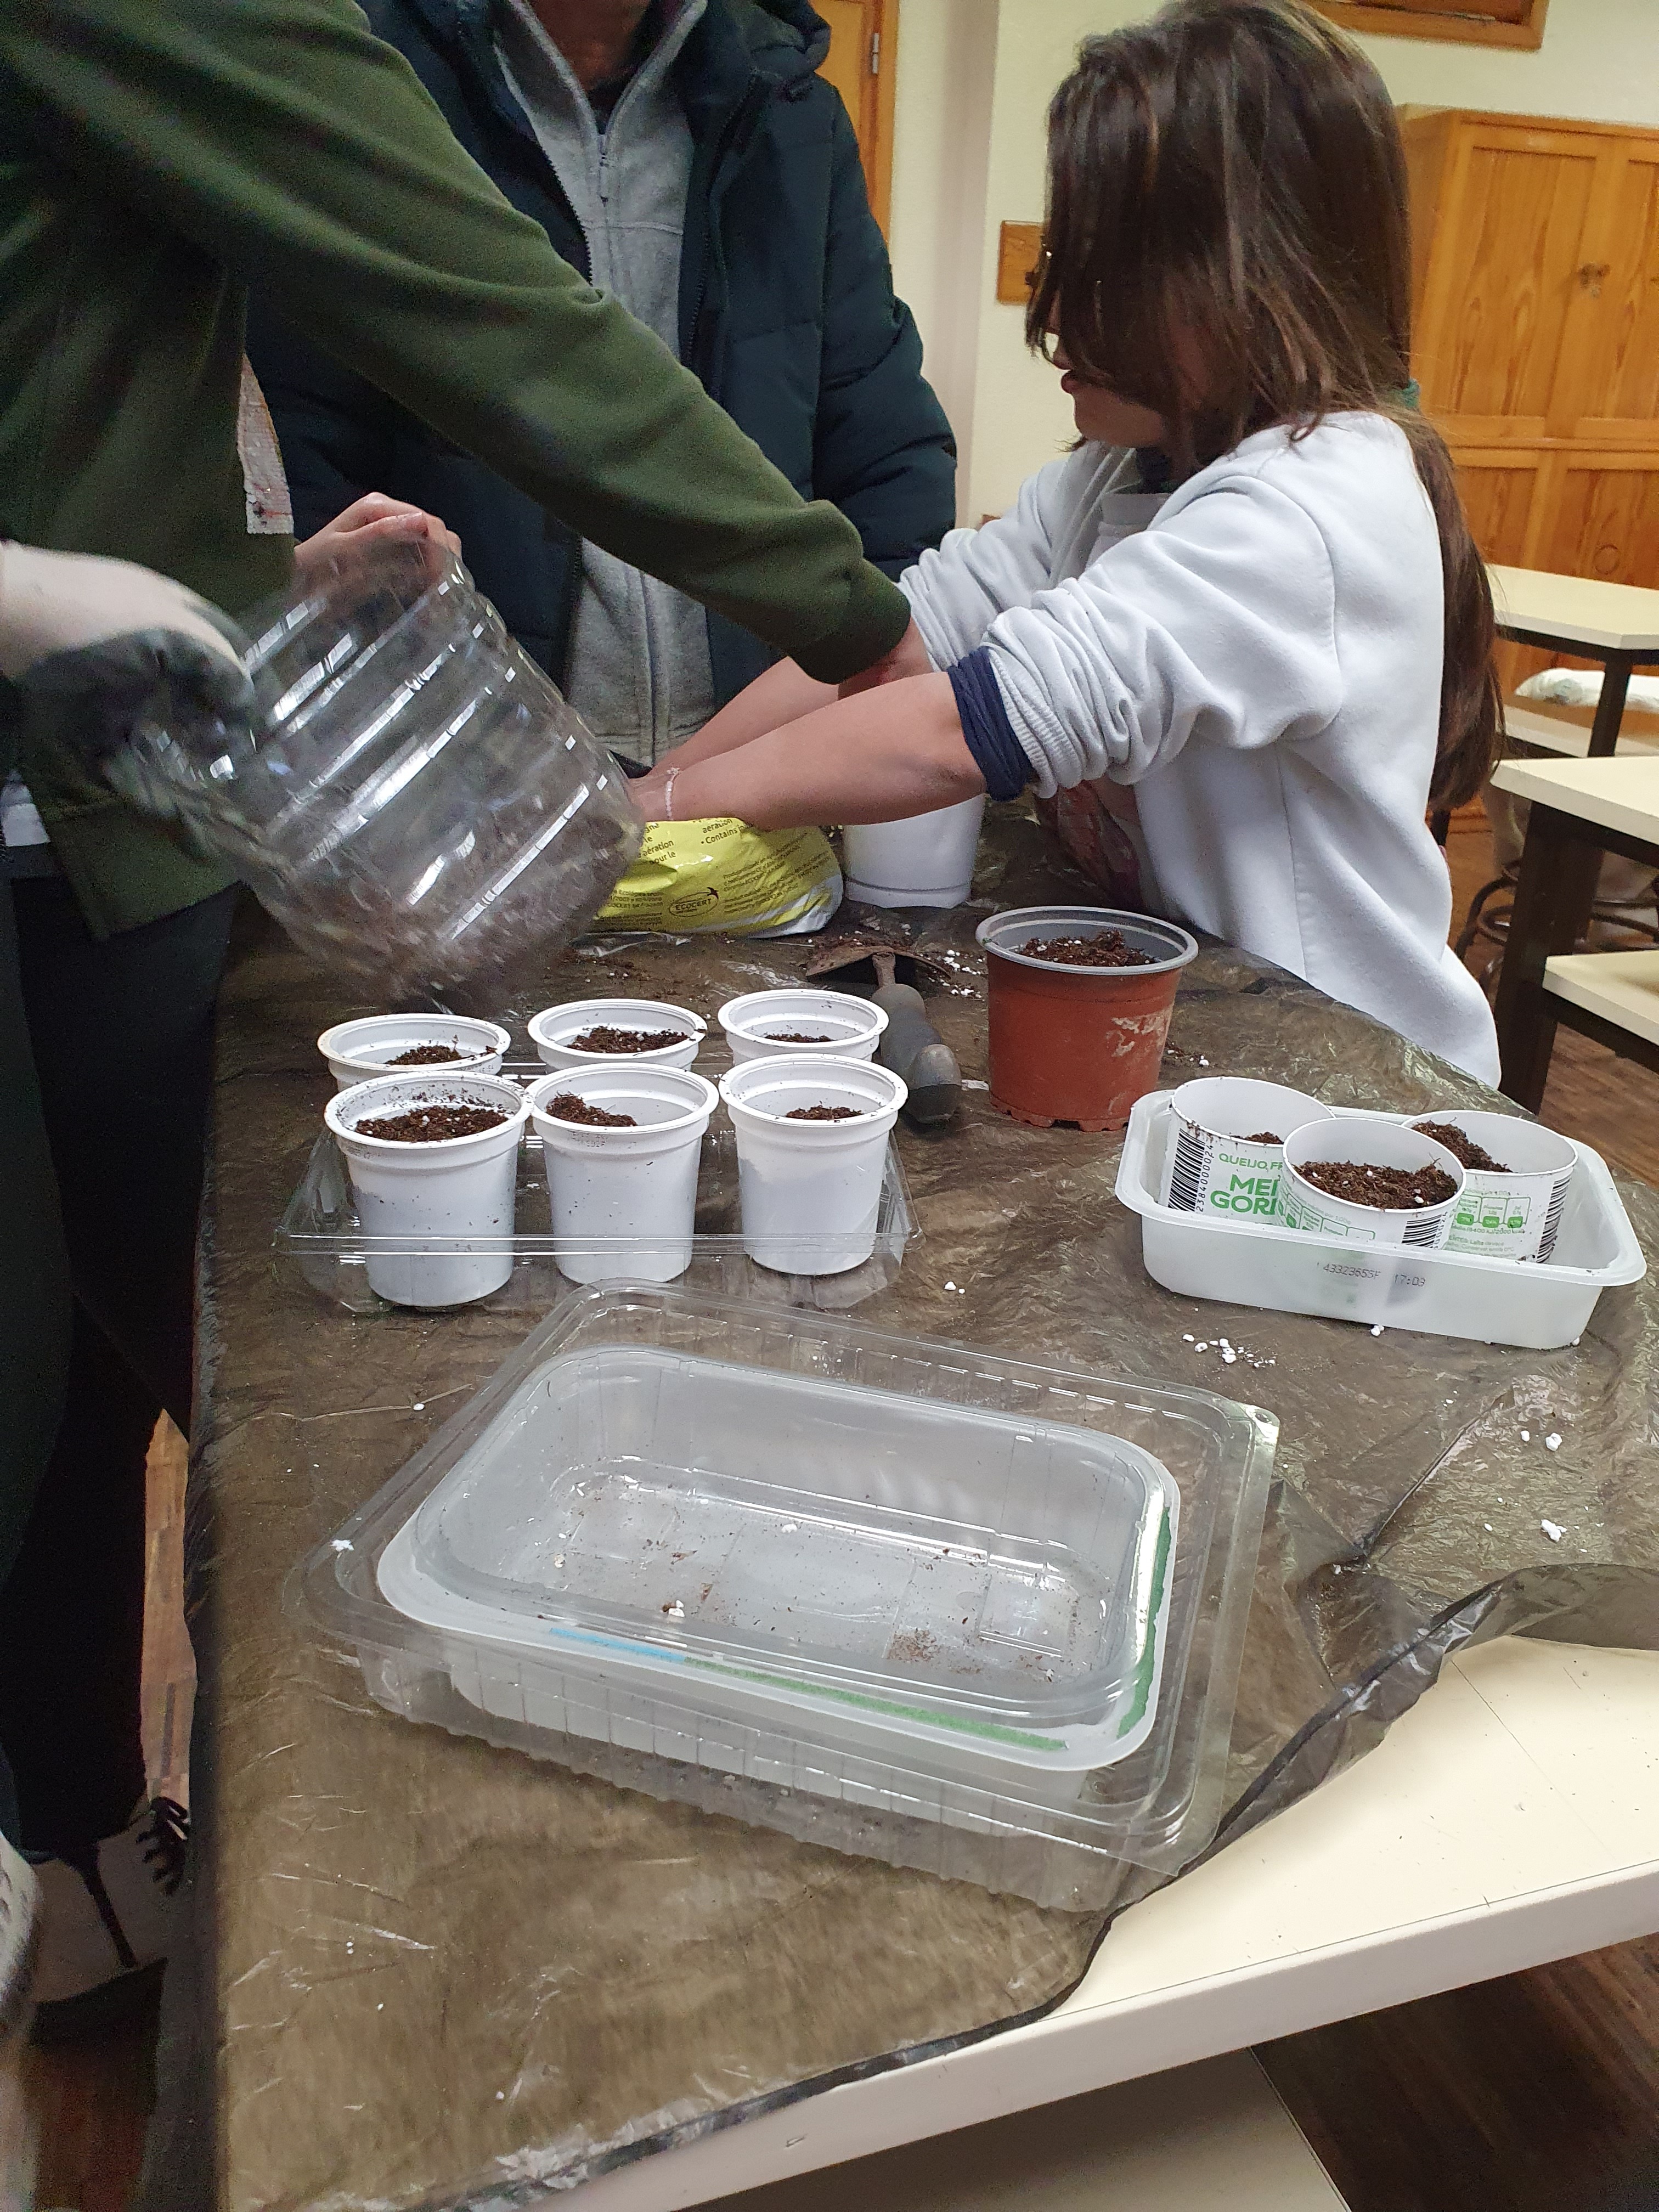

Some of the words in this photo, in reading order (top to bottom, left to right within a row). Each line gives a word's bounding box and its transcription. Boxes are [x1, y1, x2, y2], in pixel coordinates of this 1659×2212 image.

[702, 819, 733, 833] aeration
[706, 828, 738, 844] Contains
[642, 839, 674, 857] aération
[668, 850, 676, 859] le
[1218, 1153, 1267, 1170] QUEIJO
[1196, 1145, 1215, 1212] 2384000024
[1229, 1173, 1279, 1197] MEI
